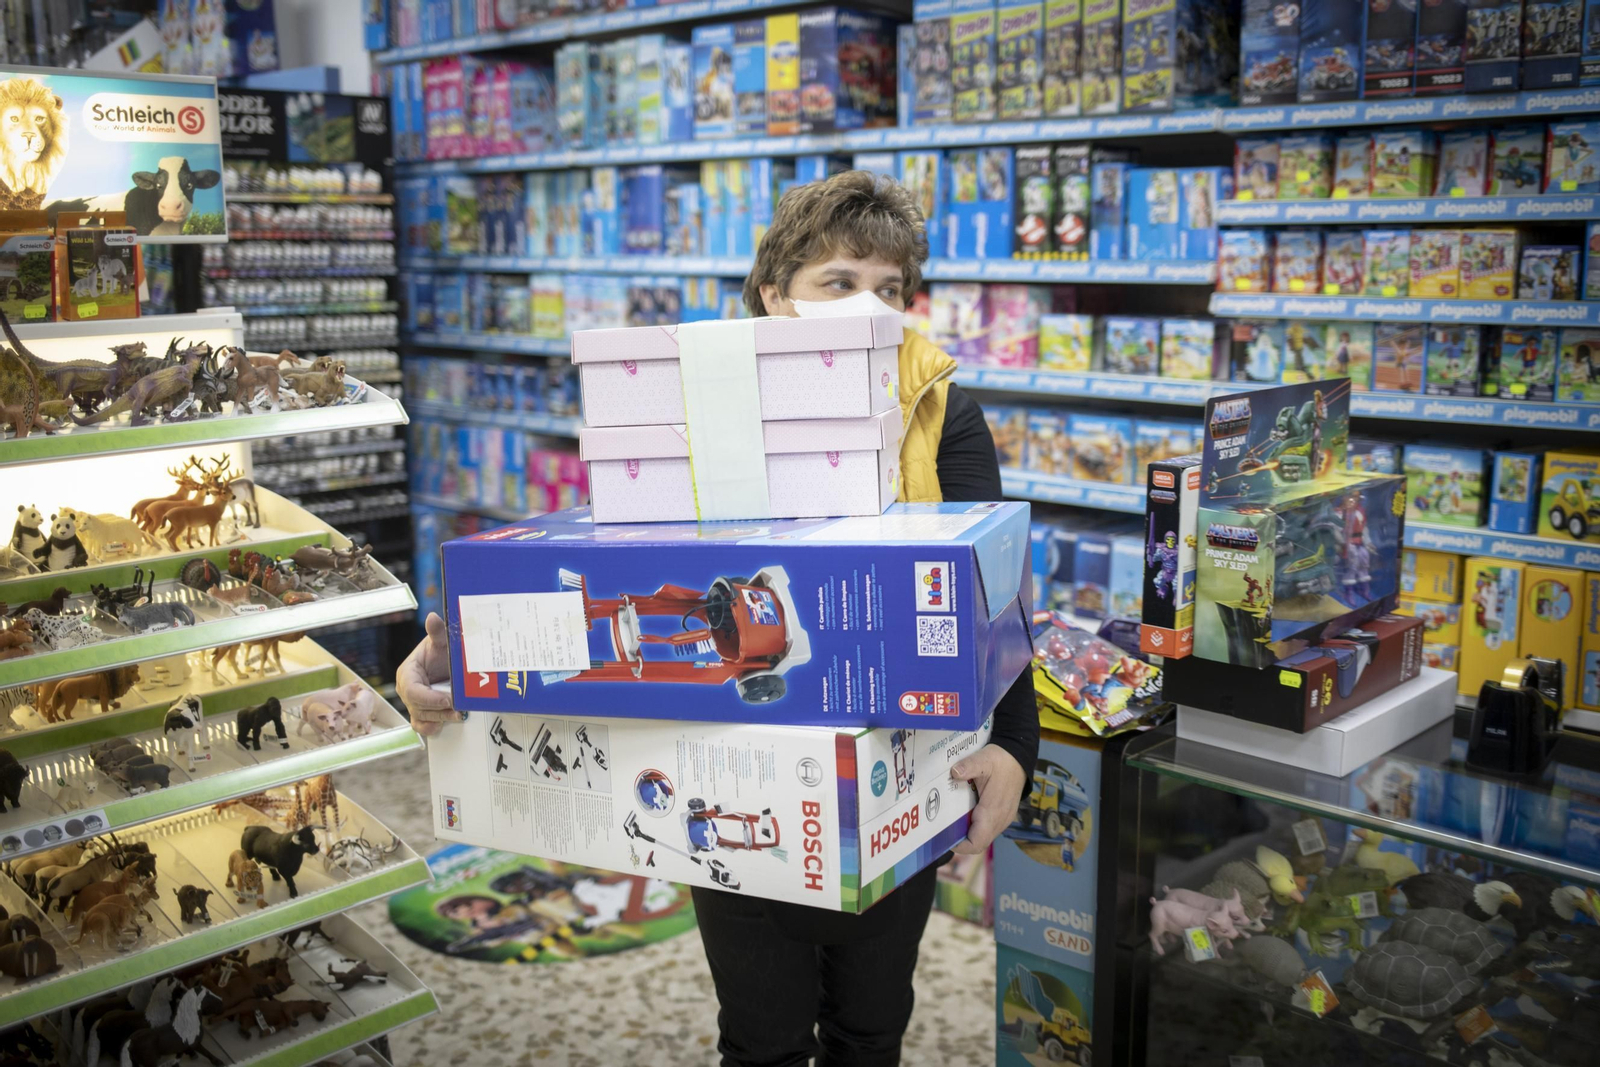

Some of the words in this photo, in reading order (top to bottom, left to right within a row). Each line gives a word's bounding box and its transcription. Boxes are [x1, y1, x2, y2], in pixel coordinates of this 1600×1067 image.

[218, 95, 271, 114] ODEL
[1443, 97, 1516, 116] playmobil
[1526, 92, 1600, 110] playmobi
[92, 103, 175, 124] Schleich
[1292, 106, 1356, 124] playmobil
[1365, 101, 1434, 121] playmobil
[114, 124, 134, 132] World
[220, 115, 276, 135] OLOR
[1358, 200, 1425, 220] playmobil
[1434, 200, 1506, 218] playmobil
[1517, 198, 1594, 216] playmobil
[1354, 299, 1422, 318] playmobil
[1430, 301, 1502, 320] playmobil
[1512, 304, 1588, 322] playmobil
[1210, 398, 1251, 424] MASTERS
[1424, 402, 1494, 419] playmobil
[1504, 406, 1578, 424] playmobil
[1214, 438, 1232, 450] PRINCE
[1232, 434, 1246, 446] ADAM
[1219, 449, 1229, 460] SKY
[1228, 446, 1240, 458] SLED
[1206, 522, 1260, 542] MASTERS
[1413, 530, 1482, 549] playmobil
[1206, 548, 1232, 560] PRINCE
[1233, 554, 1258, 564] ADAM
[1492, 540, 1566, 560] playmobil
[1214, 559, 1229, 568] SKY
[1229, 562, 1248, 571] SLED
[926, 567, 943, 606] klein
[906, 698, 914, 708] 3+
[937, 694, 945, 714] 6741
[928, 737, 948, 755] cleaner
[946, 732, 978, 762] Unlimited
[870, 804, 919, 858] BOSCH
[802, 800, 823, 891] BOSCH
[1000, 892, 1094, 933] playmobil
[1047, 929, 1090, 952] SAND
